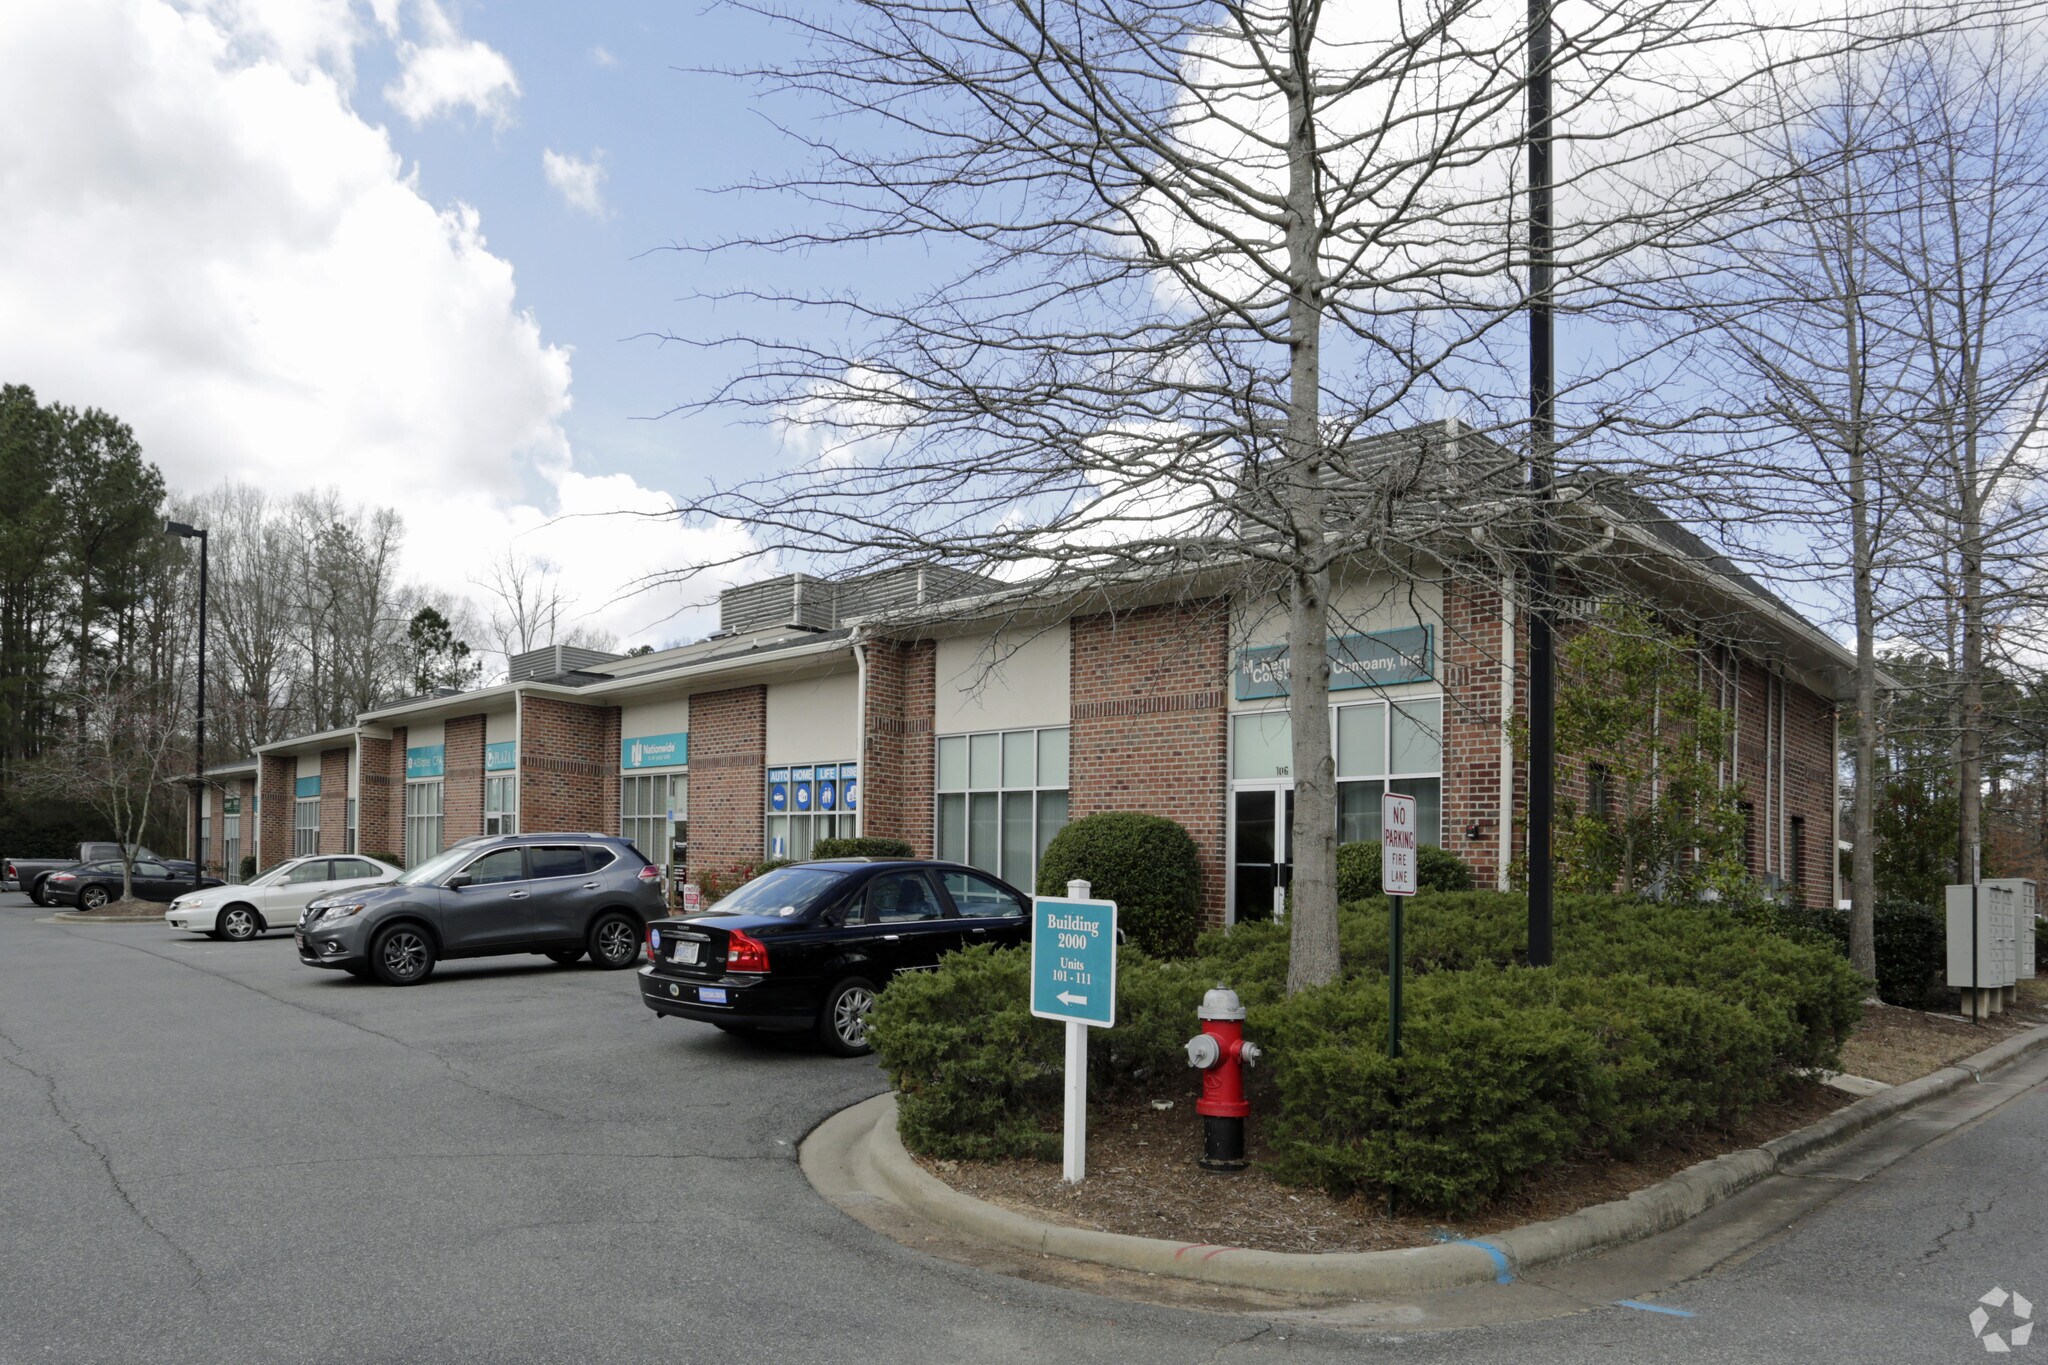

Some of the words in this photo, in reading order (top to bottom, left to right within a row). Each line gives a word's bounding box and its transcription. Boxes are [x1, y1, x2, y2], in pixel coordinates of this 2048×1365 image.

[1333, 658, 1395, 674] Company,
[643, 742, 675, 754] Nationwide
[771, 771, 788, 781] AUTO
[793, 770, 812, 780] HOME
[820, 768, 835, 778] LIFE
[842, 766, 857, 777] BUSINE
[1276, 766, 1288, 776] 106
[1393, 806, 1405, 825] NO
[1386, 829, 1413, 849] PARKING
[1392, 853, 1406, 866] FIRE
[1392, 870, 1407, 883] LANE
[1048, 914, 1099, 938] Building
[1058, 933, 1087, 950] 2000
[1060, 957, 1084, 970] Units
[1053, 970, 1067, 981] 101
[1076, 973, 1091, 984] 111
